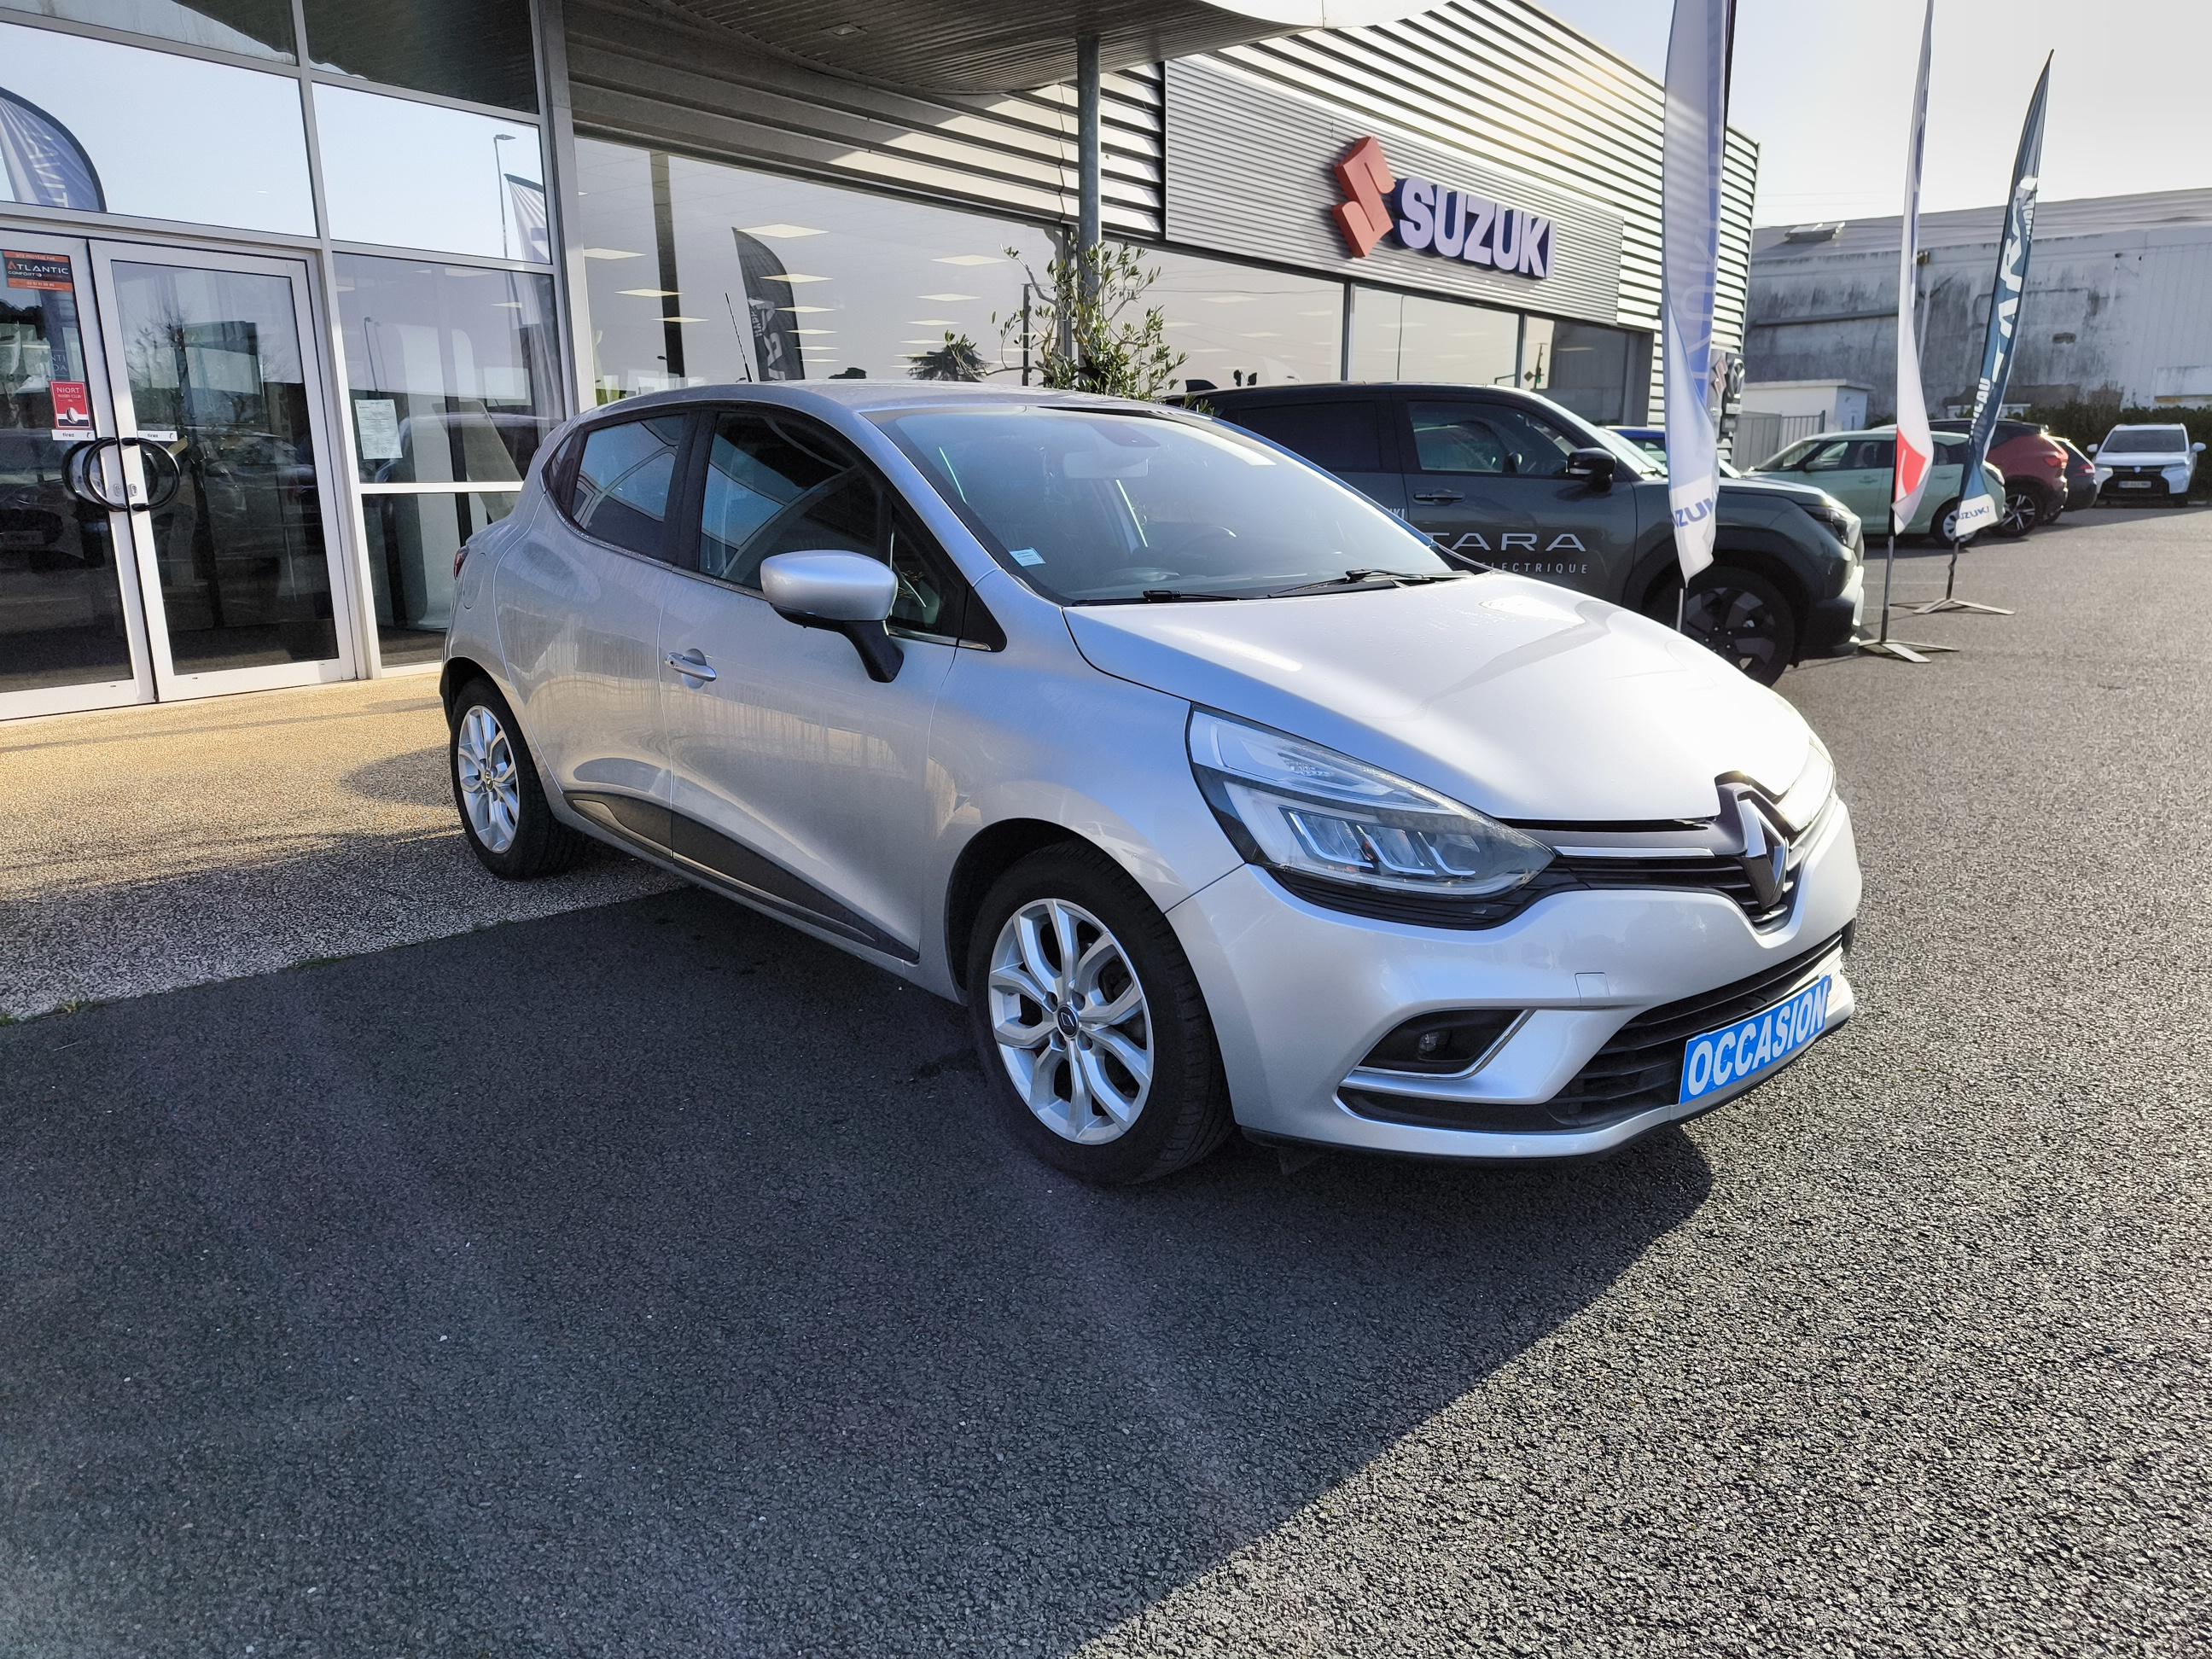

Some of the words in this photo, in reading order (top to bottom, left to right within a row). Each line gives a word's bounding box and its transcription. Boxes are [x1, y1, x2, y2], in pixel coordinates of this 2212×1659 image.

[1399, 177, 1557, 280] SUZUKI
[8, 260, 69, 275] ATLANTIC
[1482, 562, 1588, 574] ECTRIQUE
[1687, 981, 1829, 1096] OCCASION
